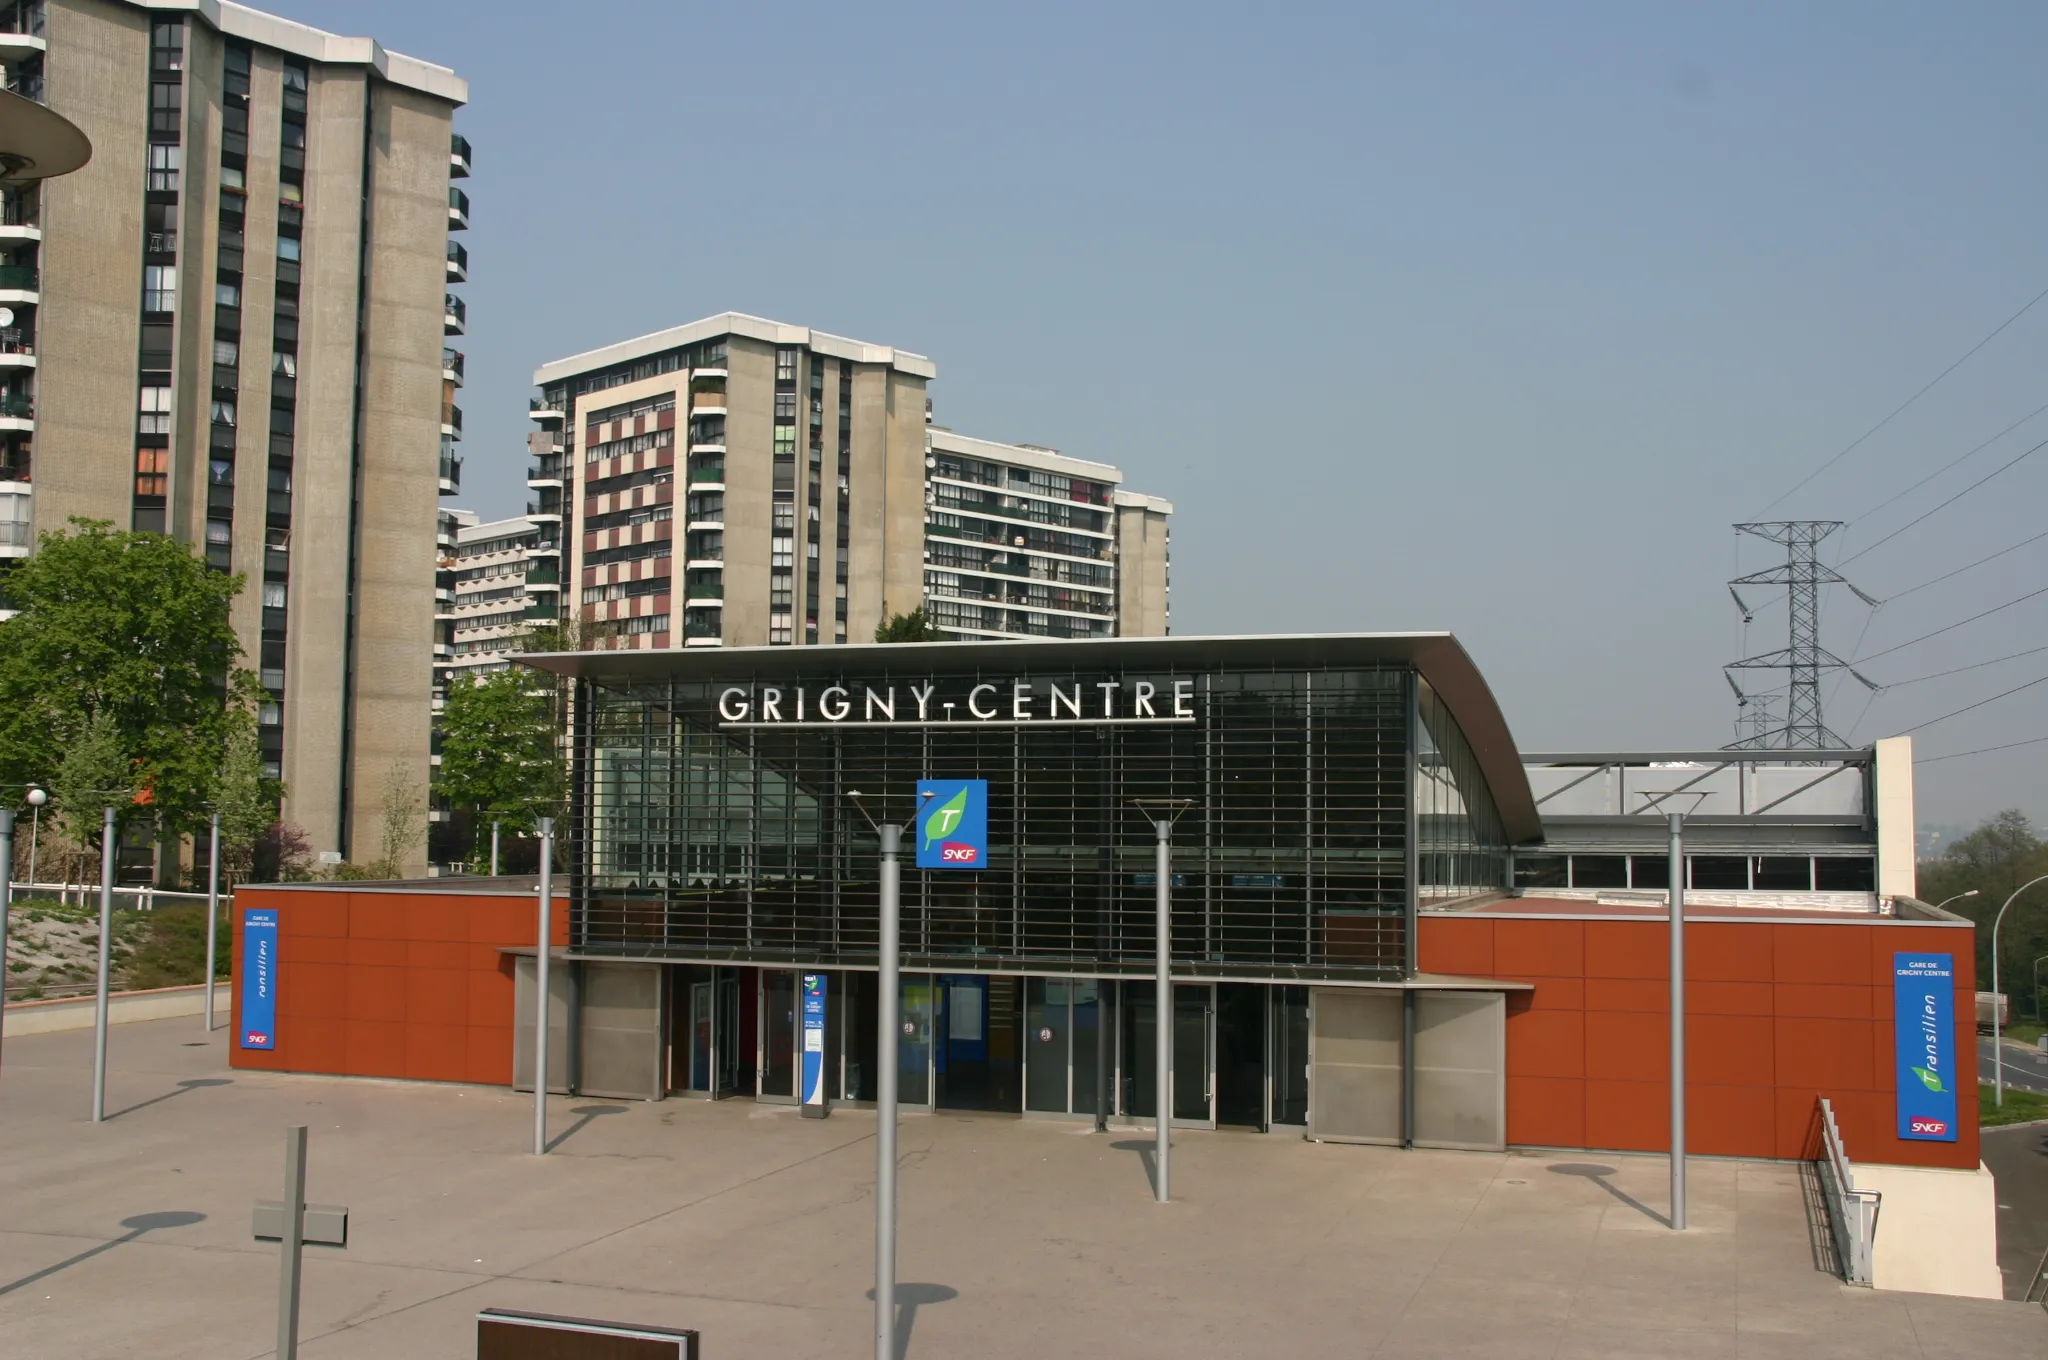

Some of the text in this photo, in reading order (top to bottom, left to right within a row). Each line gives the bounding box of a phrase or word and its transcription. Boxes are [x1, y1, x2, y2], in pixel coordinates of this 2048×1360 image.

[718, 680, 1194, 721] GRIGNY-CENTRE
[940, 809, 960, 832] T
[942, 849, 976, 860] SNCF
[248, 1035, 267, 1043] SNCF
[1922, 995, 1938, 1083] Transilien
[1911, 1122, 1945, 1133] SNCF
